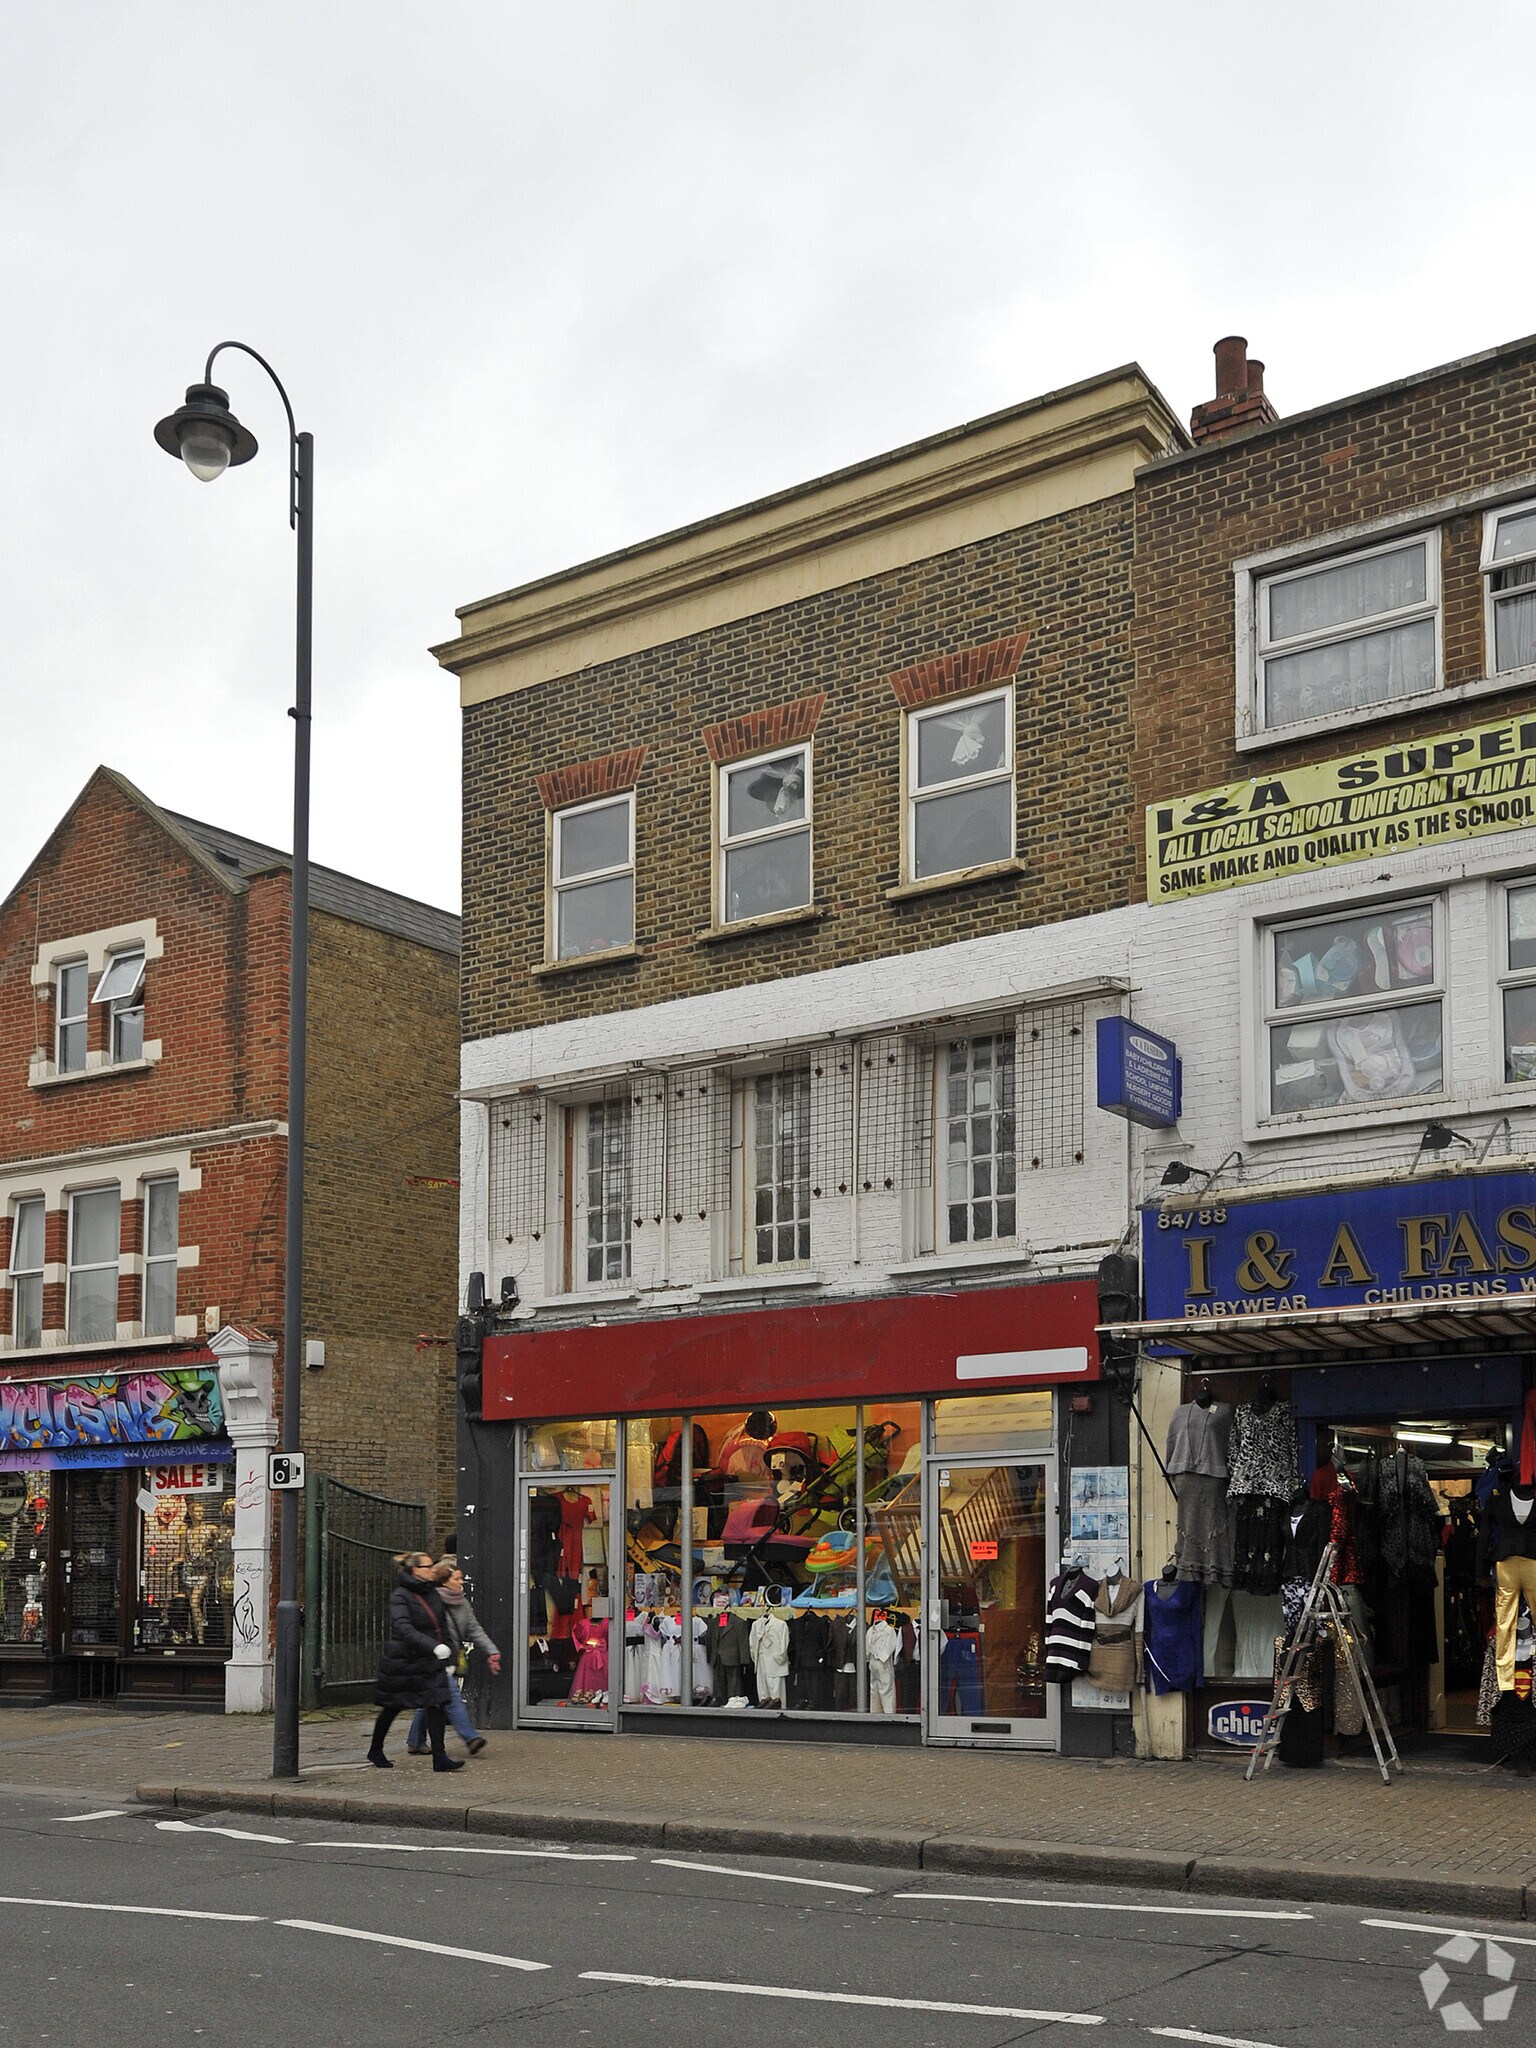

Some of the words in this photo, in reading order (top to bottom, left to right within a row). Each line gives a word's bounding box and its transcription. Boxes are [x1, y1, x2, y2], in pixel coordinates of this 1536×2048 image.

[1157, 808, 1174, 834] I
[1181, 797, 1244, 825] &
[1249, 781, 1291, 812] A
[1163, 834, 1196, 864] ALL
[1200, 819, 1260, 857] LOCAL
[1263, 800, 1344, 841] SCHOOL
[1349, 776, 1448, 822] UNIFORM
[1453, 762, 1519, 799] PLAIN
[1160, 866, 1206, 894] SAME
[1210, 853, 1258, 881] MAKE
[1263, 845, 1300, 870] AND
[1304, 826, 1380, 863] QUALITY
[1384, 820, 1410, 845] AS
[1414, 811, 1450, 838] THE
[1455, 796, 1535, 830] SCHOOL
[1125, 1070, 1148, 1087] SCHOOL
[1148, 1081, 1173, 1097] UNIFORM
[1126, 1082, 1151, 1098] NURSERY
[1151, 1093, 1172, 1108] GOODS
[1183, 1236, 1217, 1298] I
[1236, 1230, 1298, 1294] &
[1318, 1222, 1379, 1287] A
[1397, 1203, 1536, 1281] FAS
[1184, 1294, 1308, 1319] BABYWEAR
[1364, 1278, 1508, 1304] CHILDRENS
[155, 1464, 204, 1489] SALE
[1216, 1705, 1277, 1736] chic
